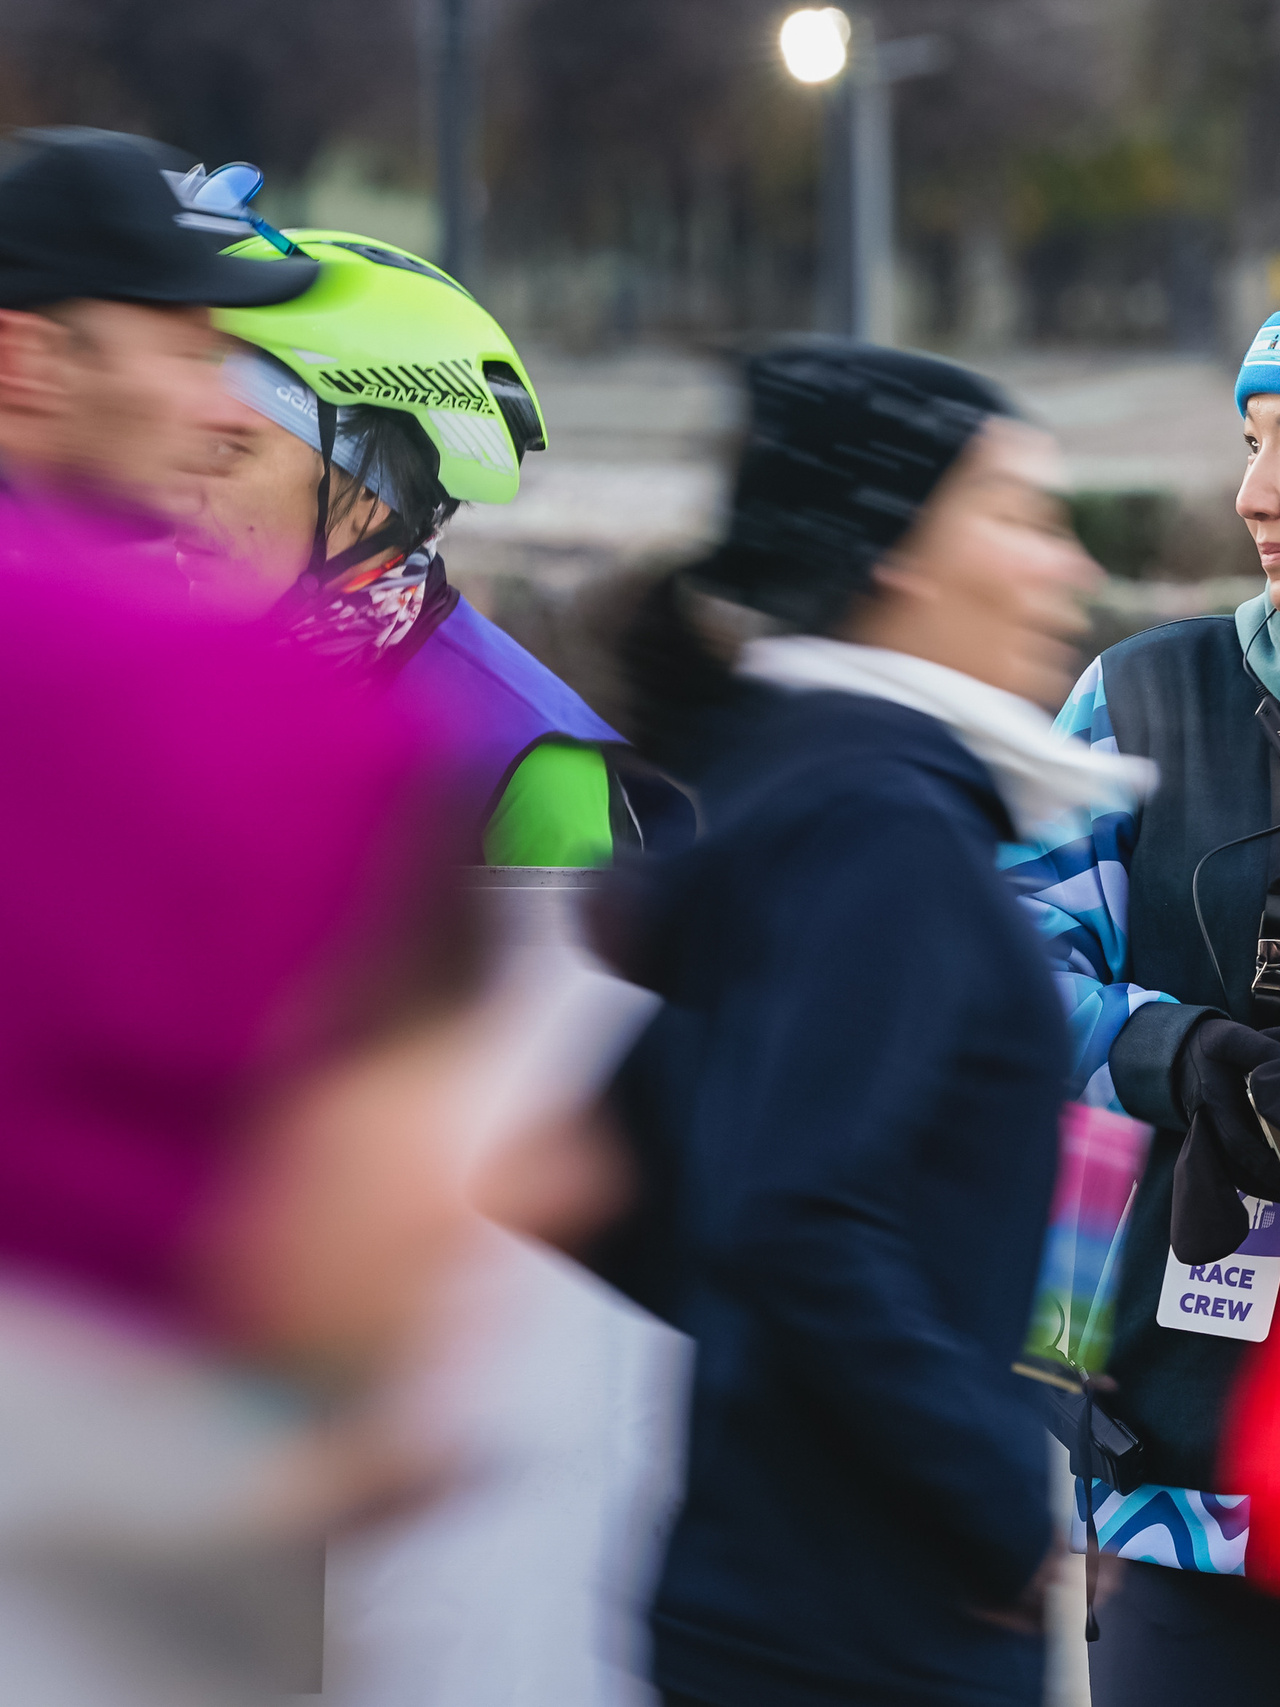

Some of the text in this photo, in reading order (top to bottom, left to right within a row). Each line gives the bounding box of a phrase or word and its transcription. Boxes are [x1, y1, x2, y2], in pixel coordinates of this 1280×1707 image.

[360, 382, 496, 416] BONTRAGER
[1188, 1263, 1256, 1290] RACE
[1179, 1292, 1253, 1322] CREW
